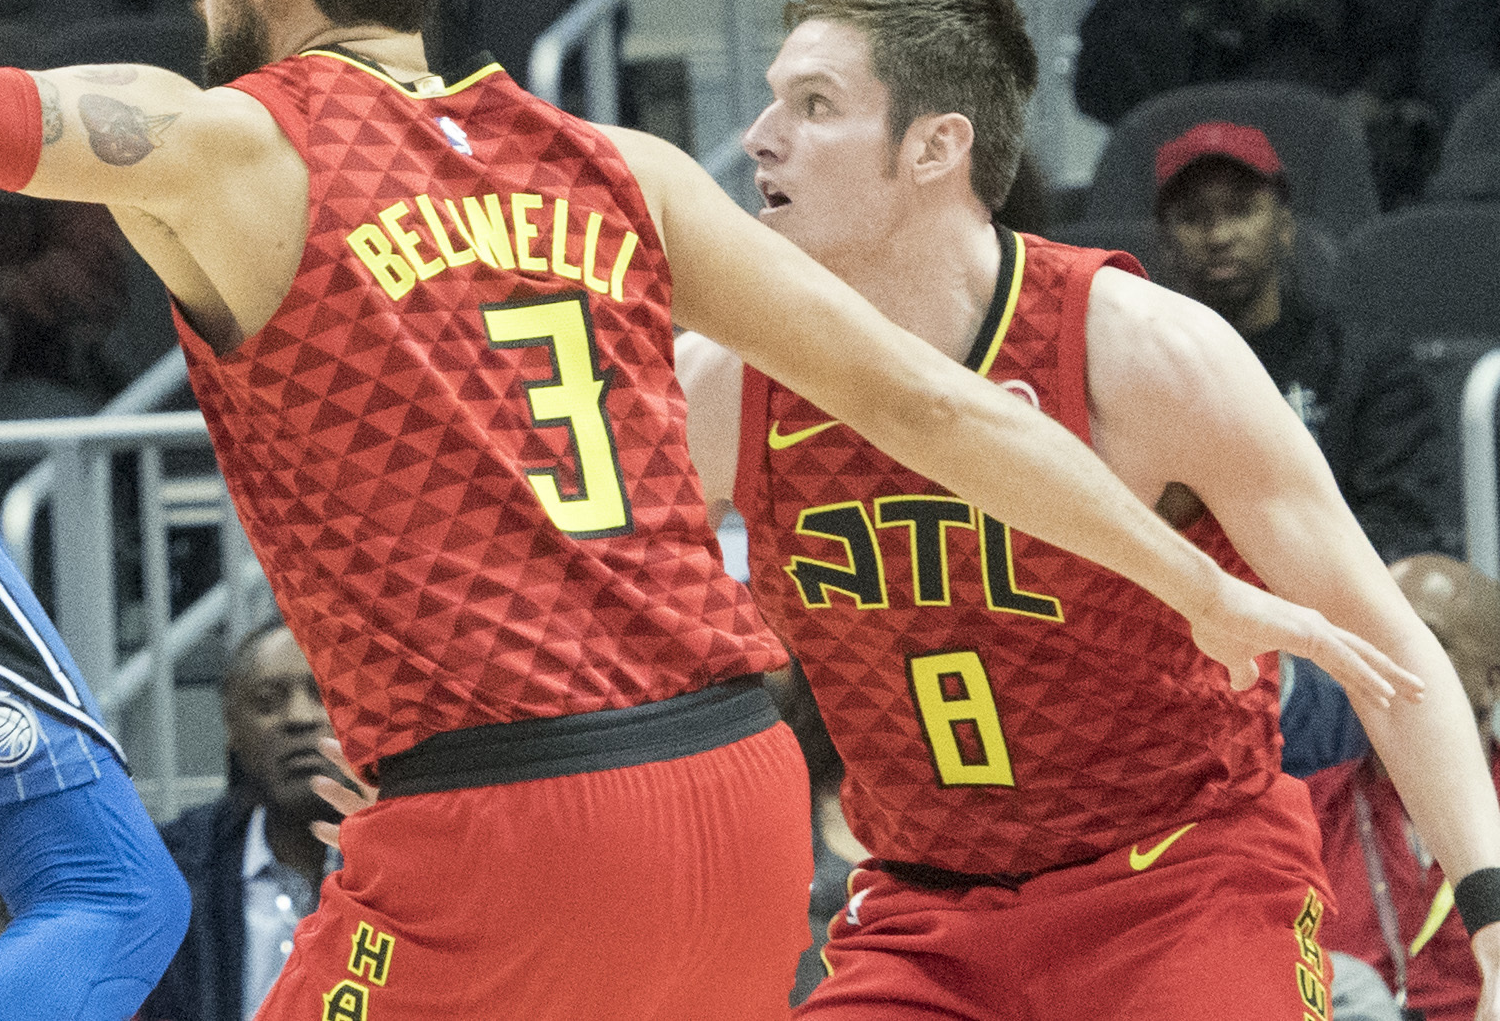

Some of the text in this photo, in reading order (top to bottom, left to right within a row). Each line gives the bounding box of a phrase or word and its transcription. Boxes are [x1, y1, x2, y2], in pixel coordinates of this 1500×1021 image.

[479, 289, 636, 540] 3
[783, 494, 1065, 623] ATL
[908, 647, 1016, 790] 8
